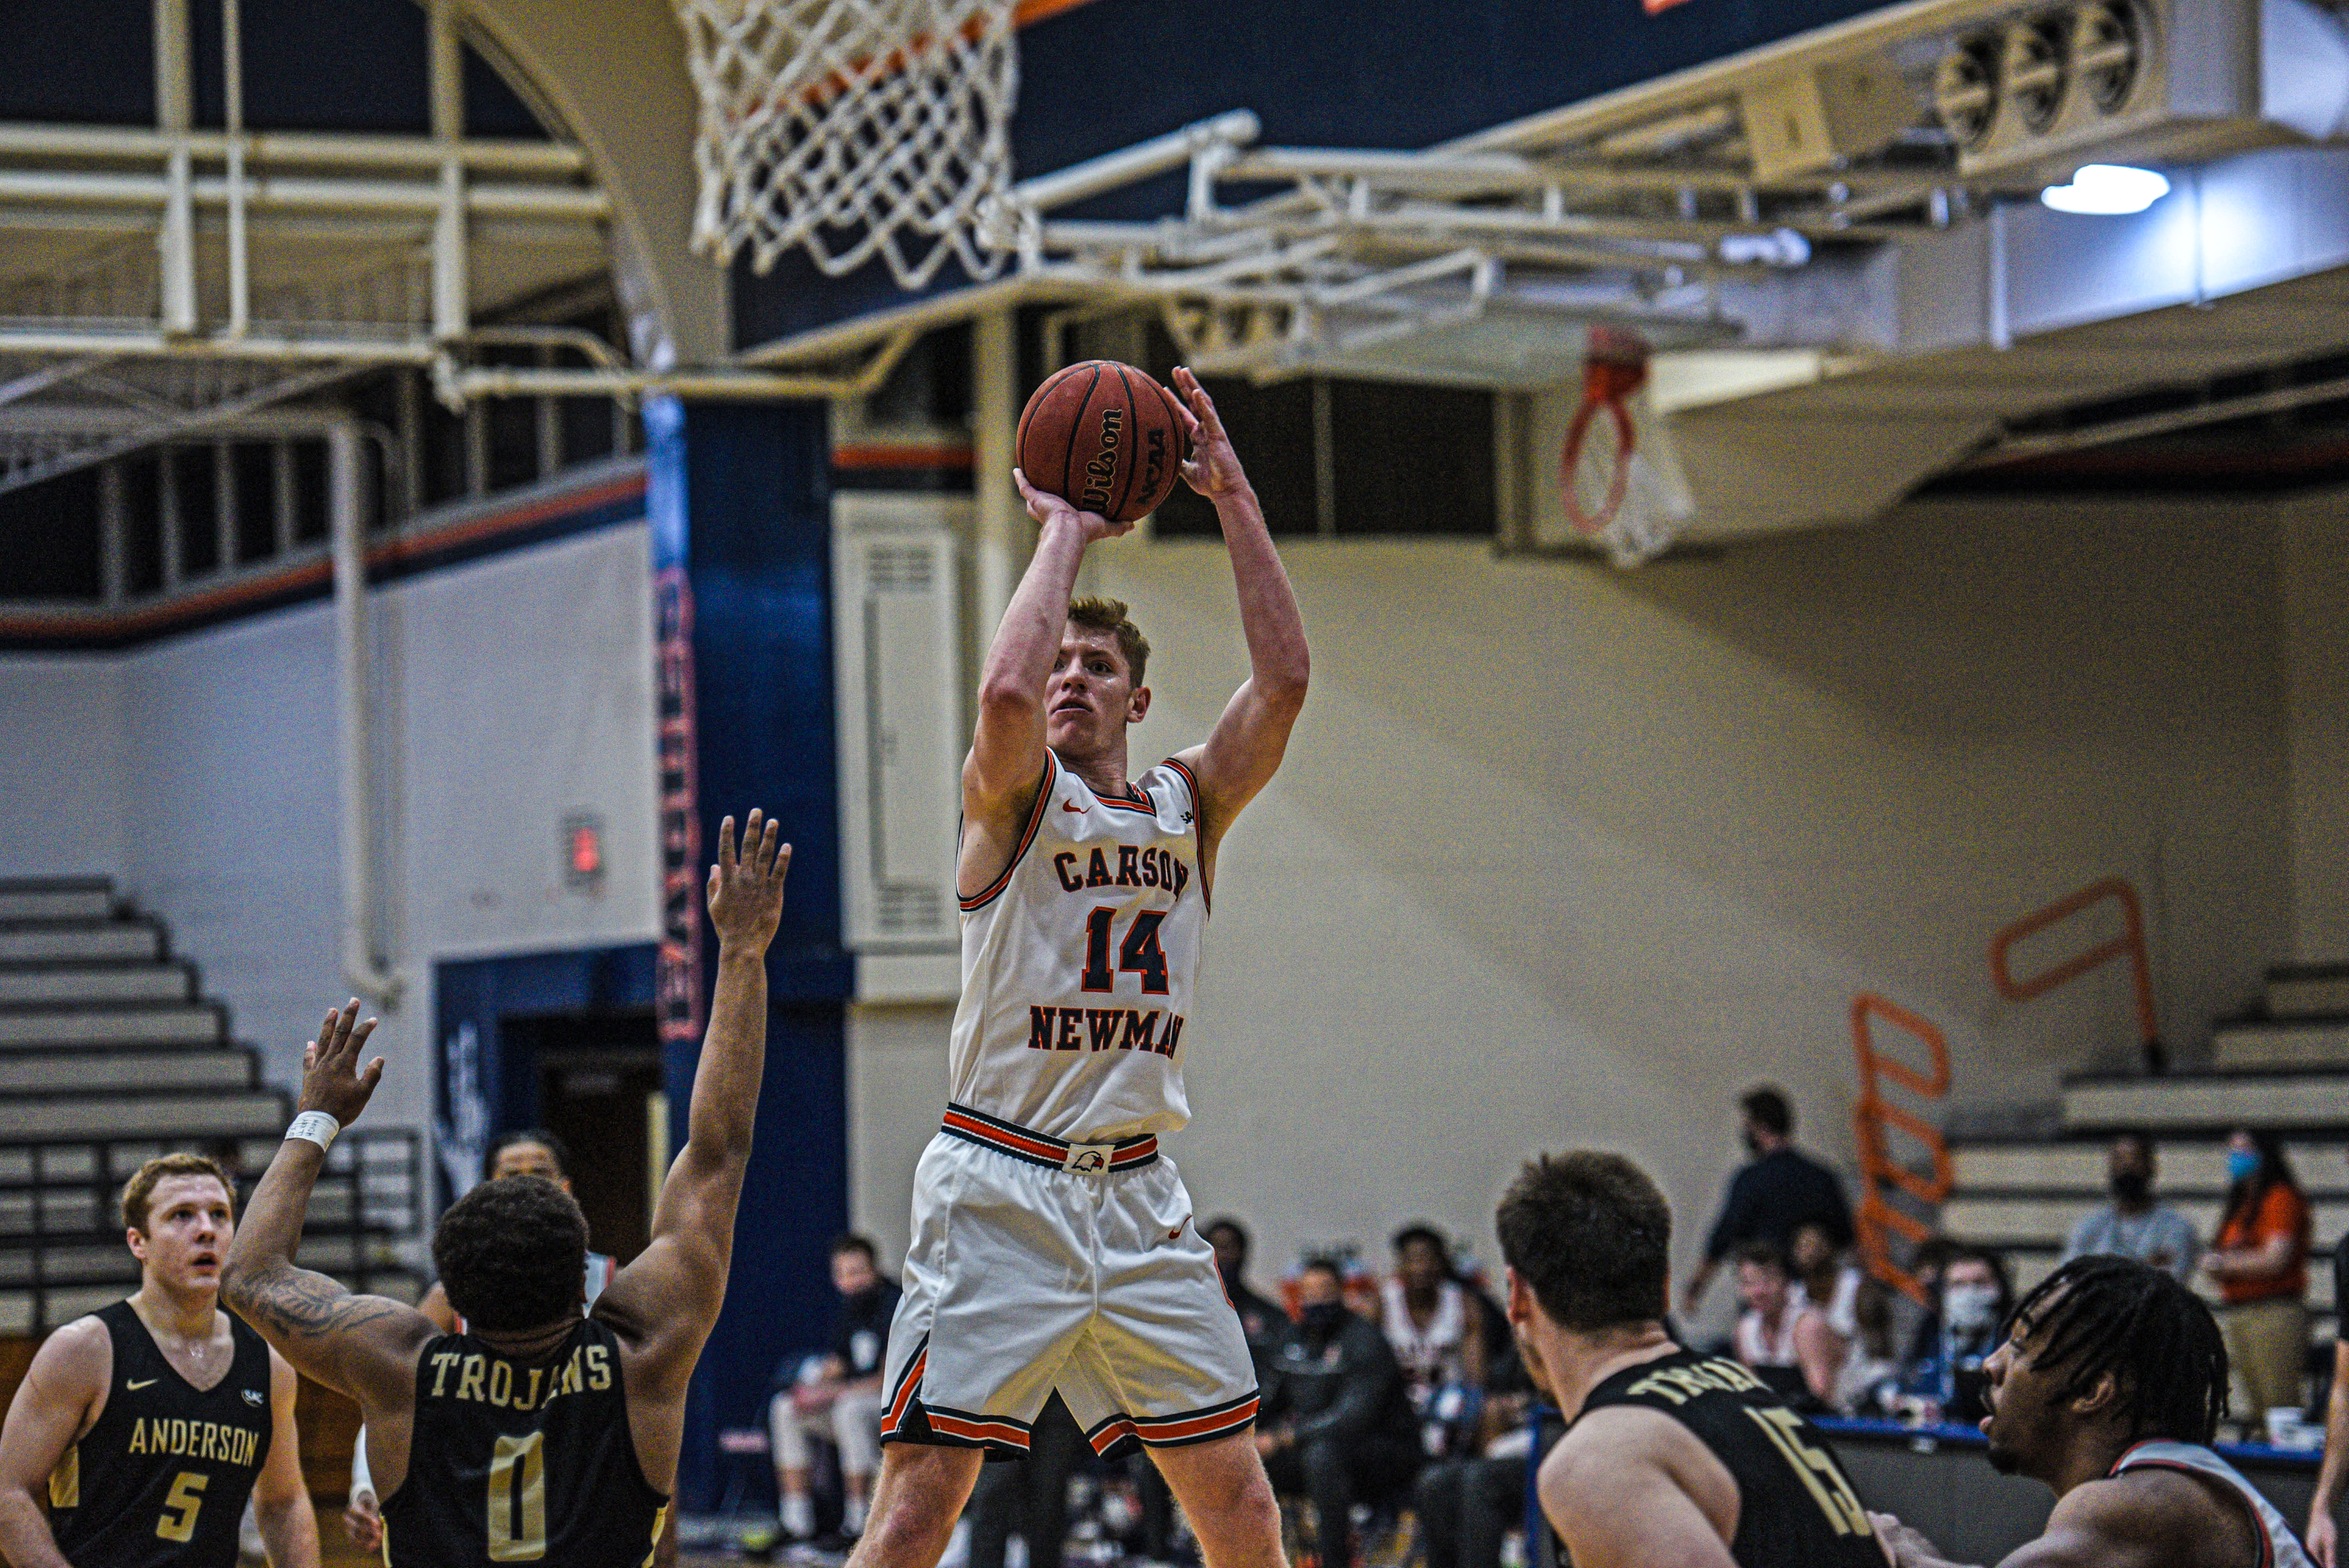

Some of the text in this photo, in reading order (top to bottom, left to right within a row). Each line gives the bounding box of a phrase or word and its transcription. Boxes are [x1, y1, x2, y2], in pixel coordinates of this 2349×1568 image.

[1081, 408, 1123, 513] Wilson
[1136, 428, 1166, 505] NCAA
[1053, 844, 1190, 902] CARSON
[1081, 905, 1170, 996] 14
[1027, 1004, 1185, 1060] NEWMAN
[429, 1344, 613, 1412] TROJANS
[127, 1416, 260, 1468] ANDERSON
[1742, 1404, 1874, 1537] 15
[155, 1470, 210, 1544] 5
[486, 1431, 547, 1563] 0
